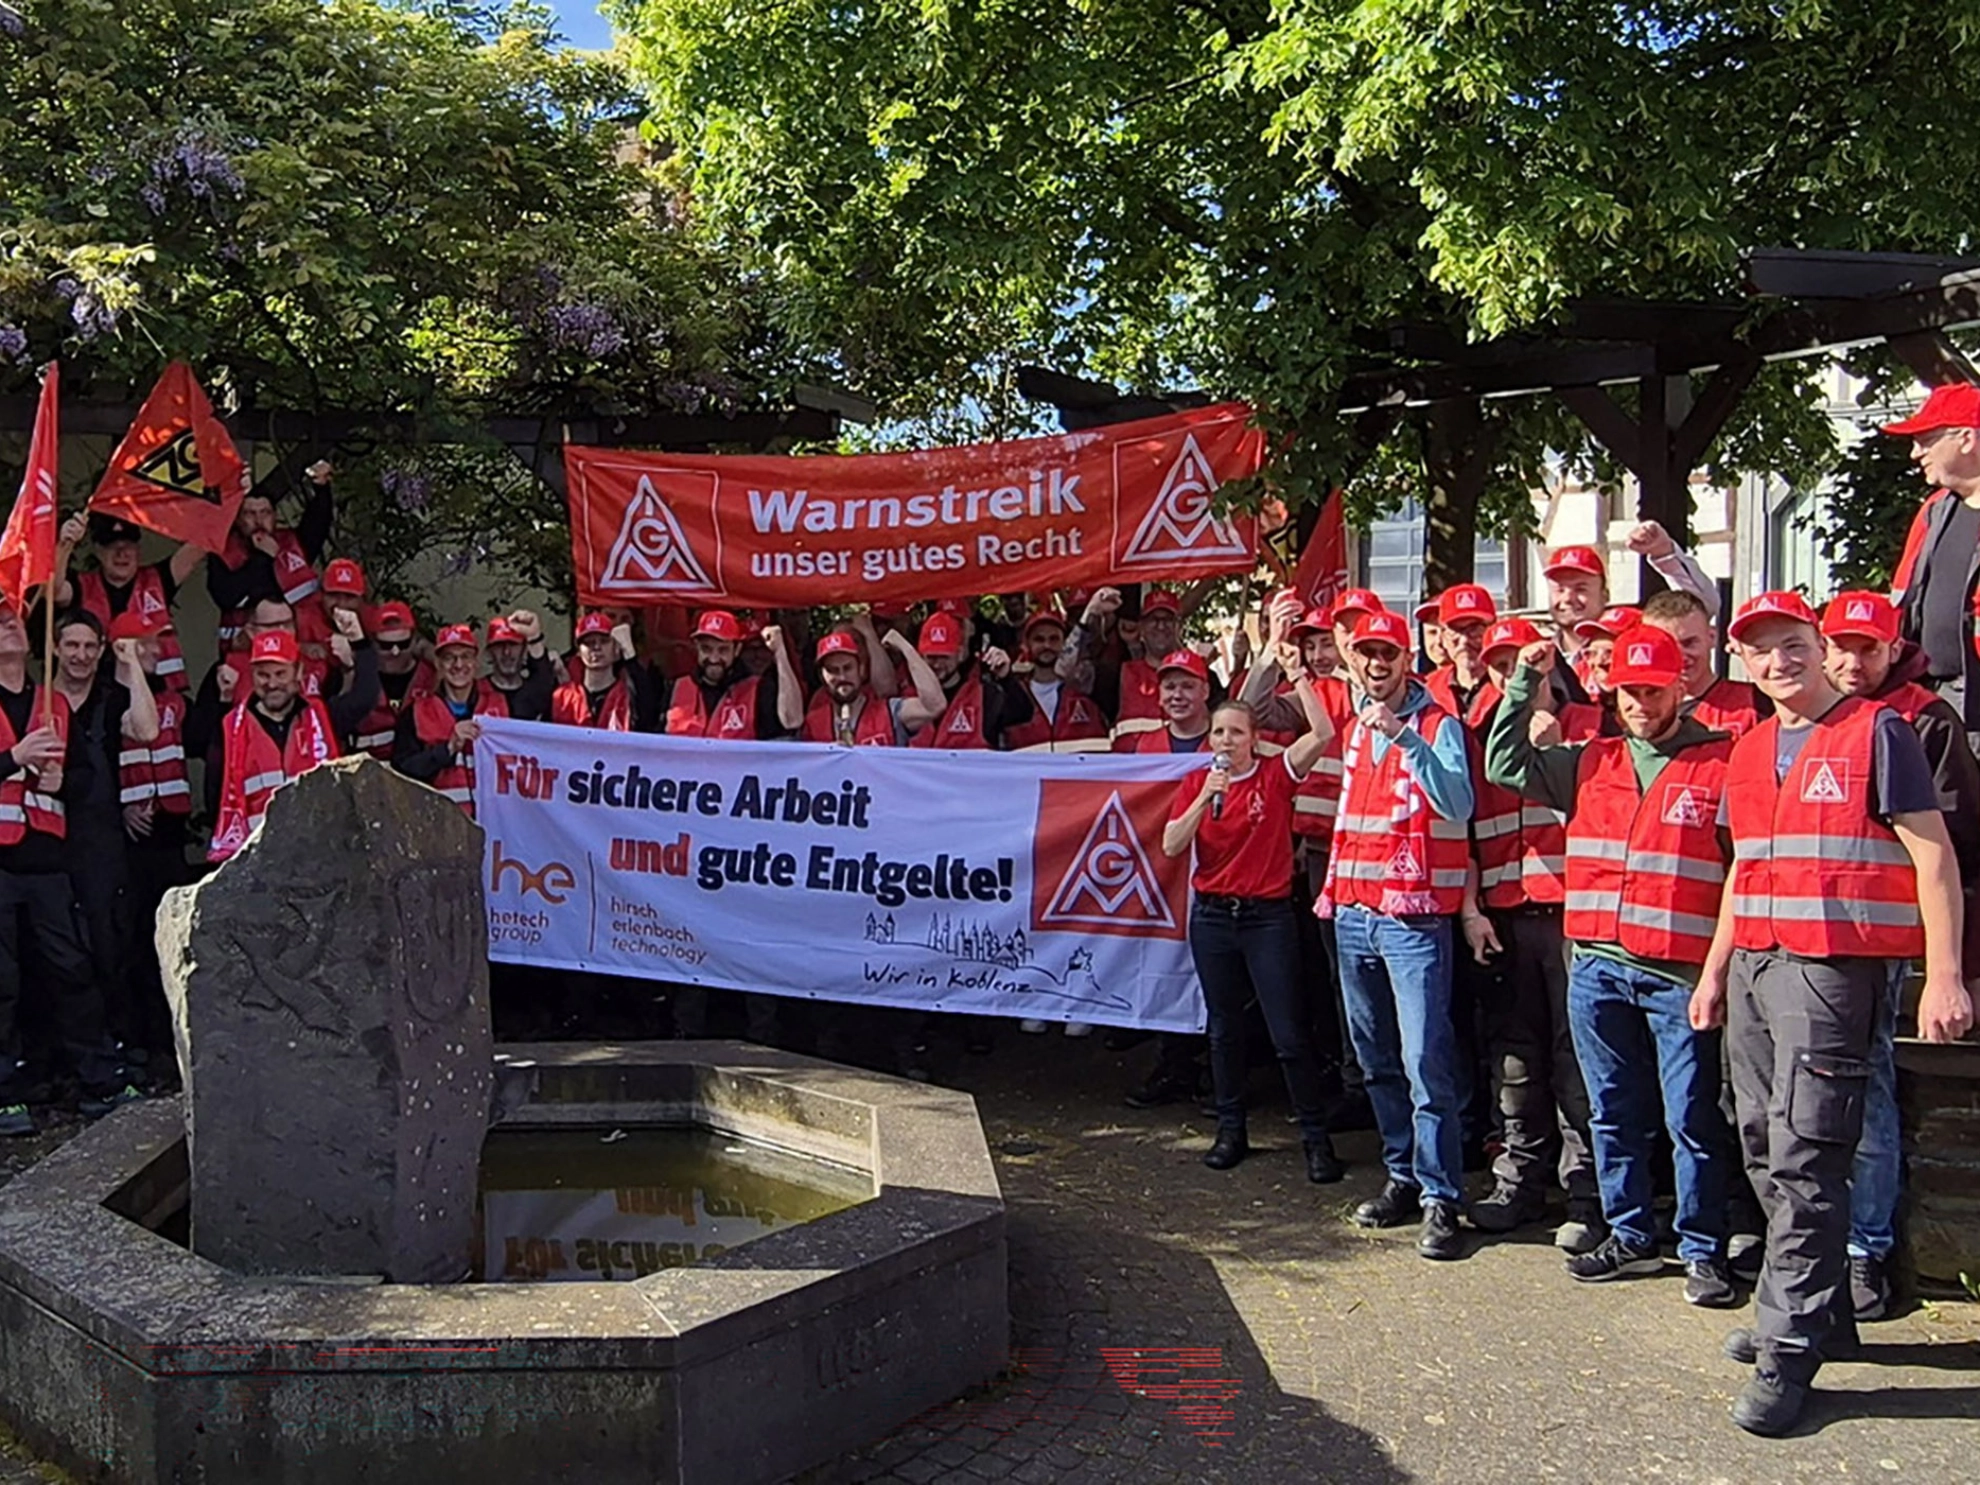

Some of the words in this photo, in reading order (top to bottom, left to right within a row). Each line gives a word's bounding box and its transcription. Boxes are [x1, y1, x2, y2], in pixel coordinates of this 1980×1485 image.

[748, 469, 1086, 535] Warnstreik
[750, 551, 850, 578] unser
[862, 540, 964, 580] gutes
[977, 528, 1083, 567] Recht
[494, 753, 560, 801] Für
[567, 760, 722, 816] sichere
[730, 775, 871, 828] Arbeit
[610, 832, 692, 877] und
[697, 843, 797, 892] gute
[806, 844, 1014, 907] Entgelte!
[490, 906, 550, 929] hetech
[611, 896, 658, 919] hirsch
[490, 927, 542, 947] group
[612, 917, 694, 944] erlenbach
[612, 936, 708, 964] technology
[864, 962, 910, 985] Wir
[916, 966, 937, 989] in
[947, 966, 1034, 995] Koblenz
